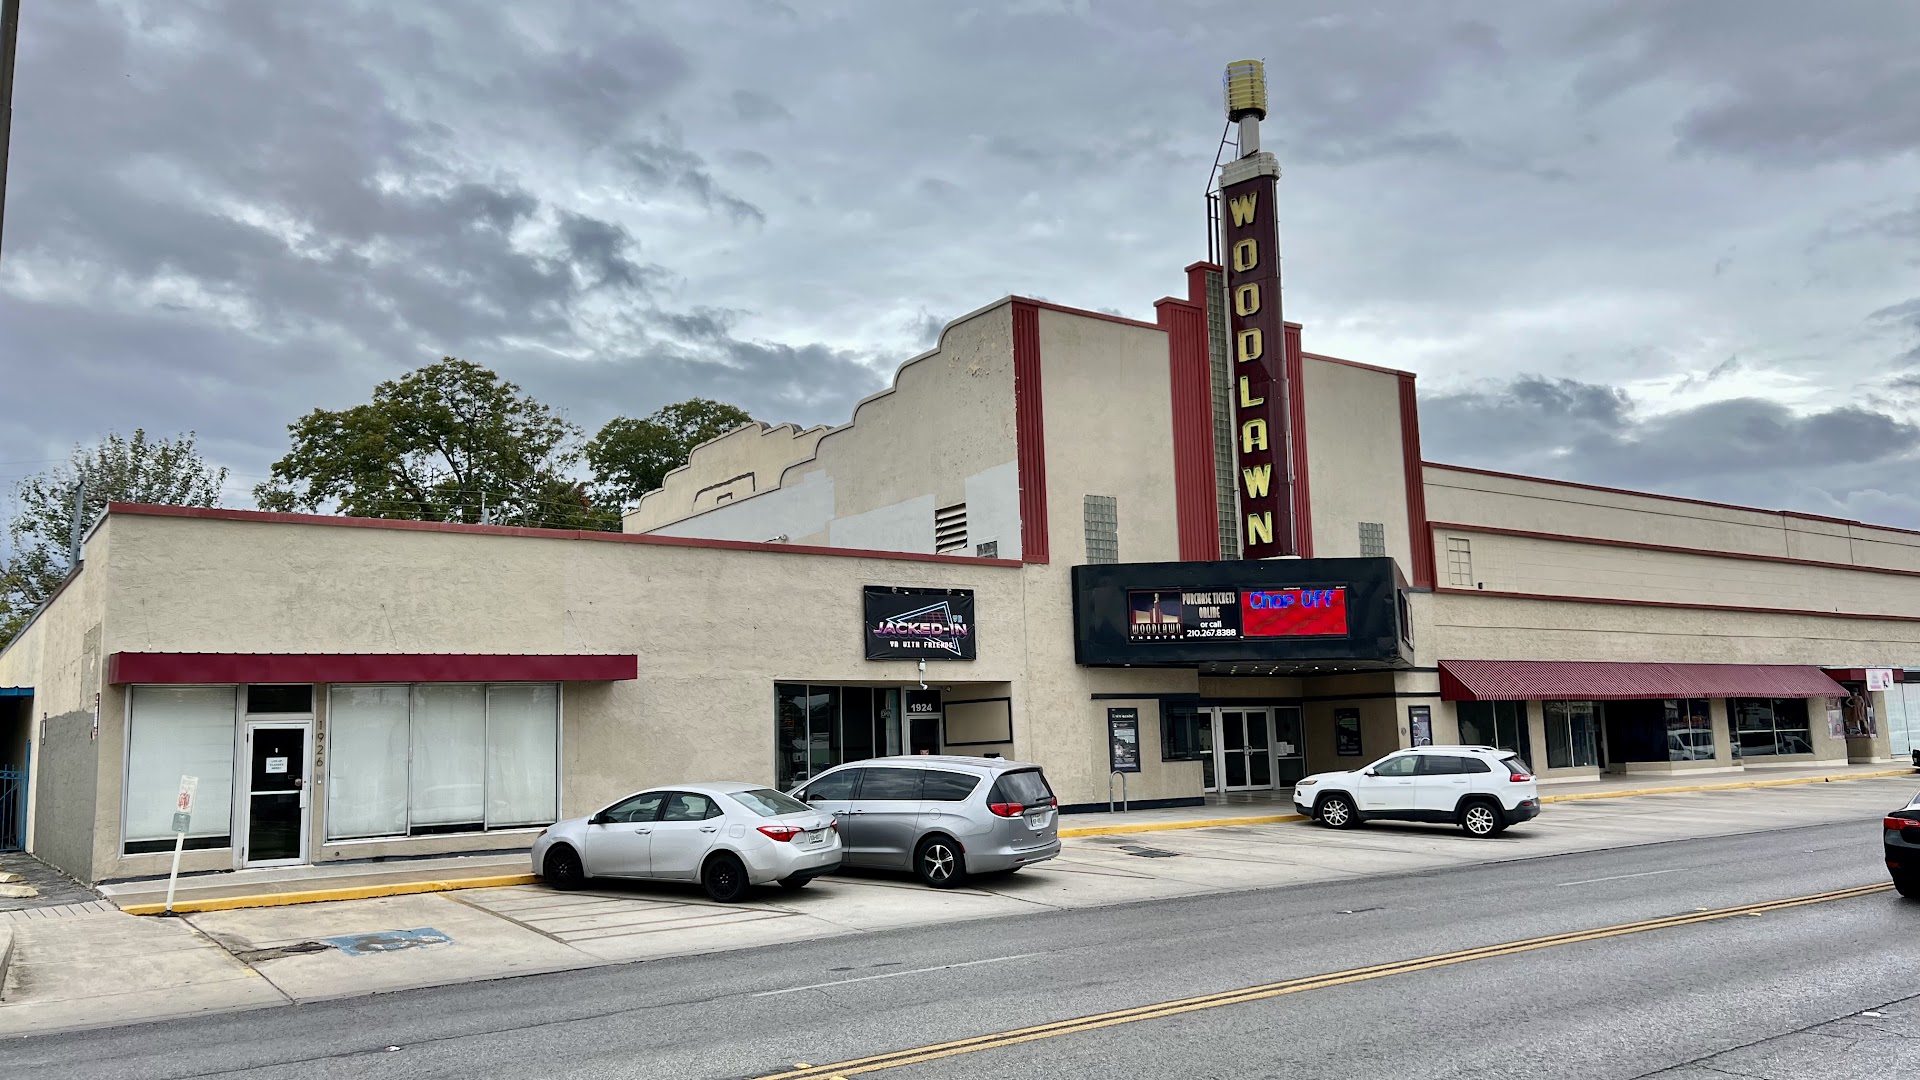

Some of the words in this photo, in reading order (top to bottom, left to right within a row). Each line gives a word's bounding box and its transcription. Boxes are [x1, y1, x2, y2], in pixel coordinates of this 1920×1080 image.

[1229, 190, 1273, 546] WOODLAWN
[1182, 592, 1212, 605] PURCHASE
[1212, 591, 1236, 604] TICKETS
[1198, 606, 1221, 619] ONLINE
[873, 621, 968, 636] JACKED-IN
[1132, 623, 1181, 634] WOODLAWN
[1209, 620, 1222, 628] call
[1186, 628, 1237, 637] 210.267.8388
[923, 641, 953, 649] FRIENDS
[911, 703, 932, 712] 1924
[316, 720, 324, 767] 1926
